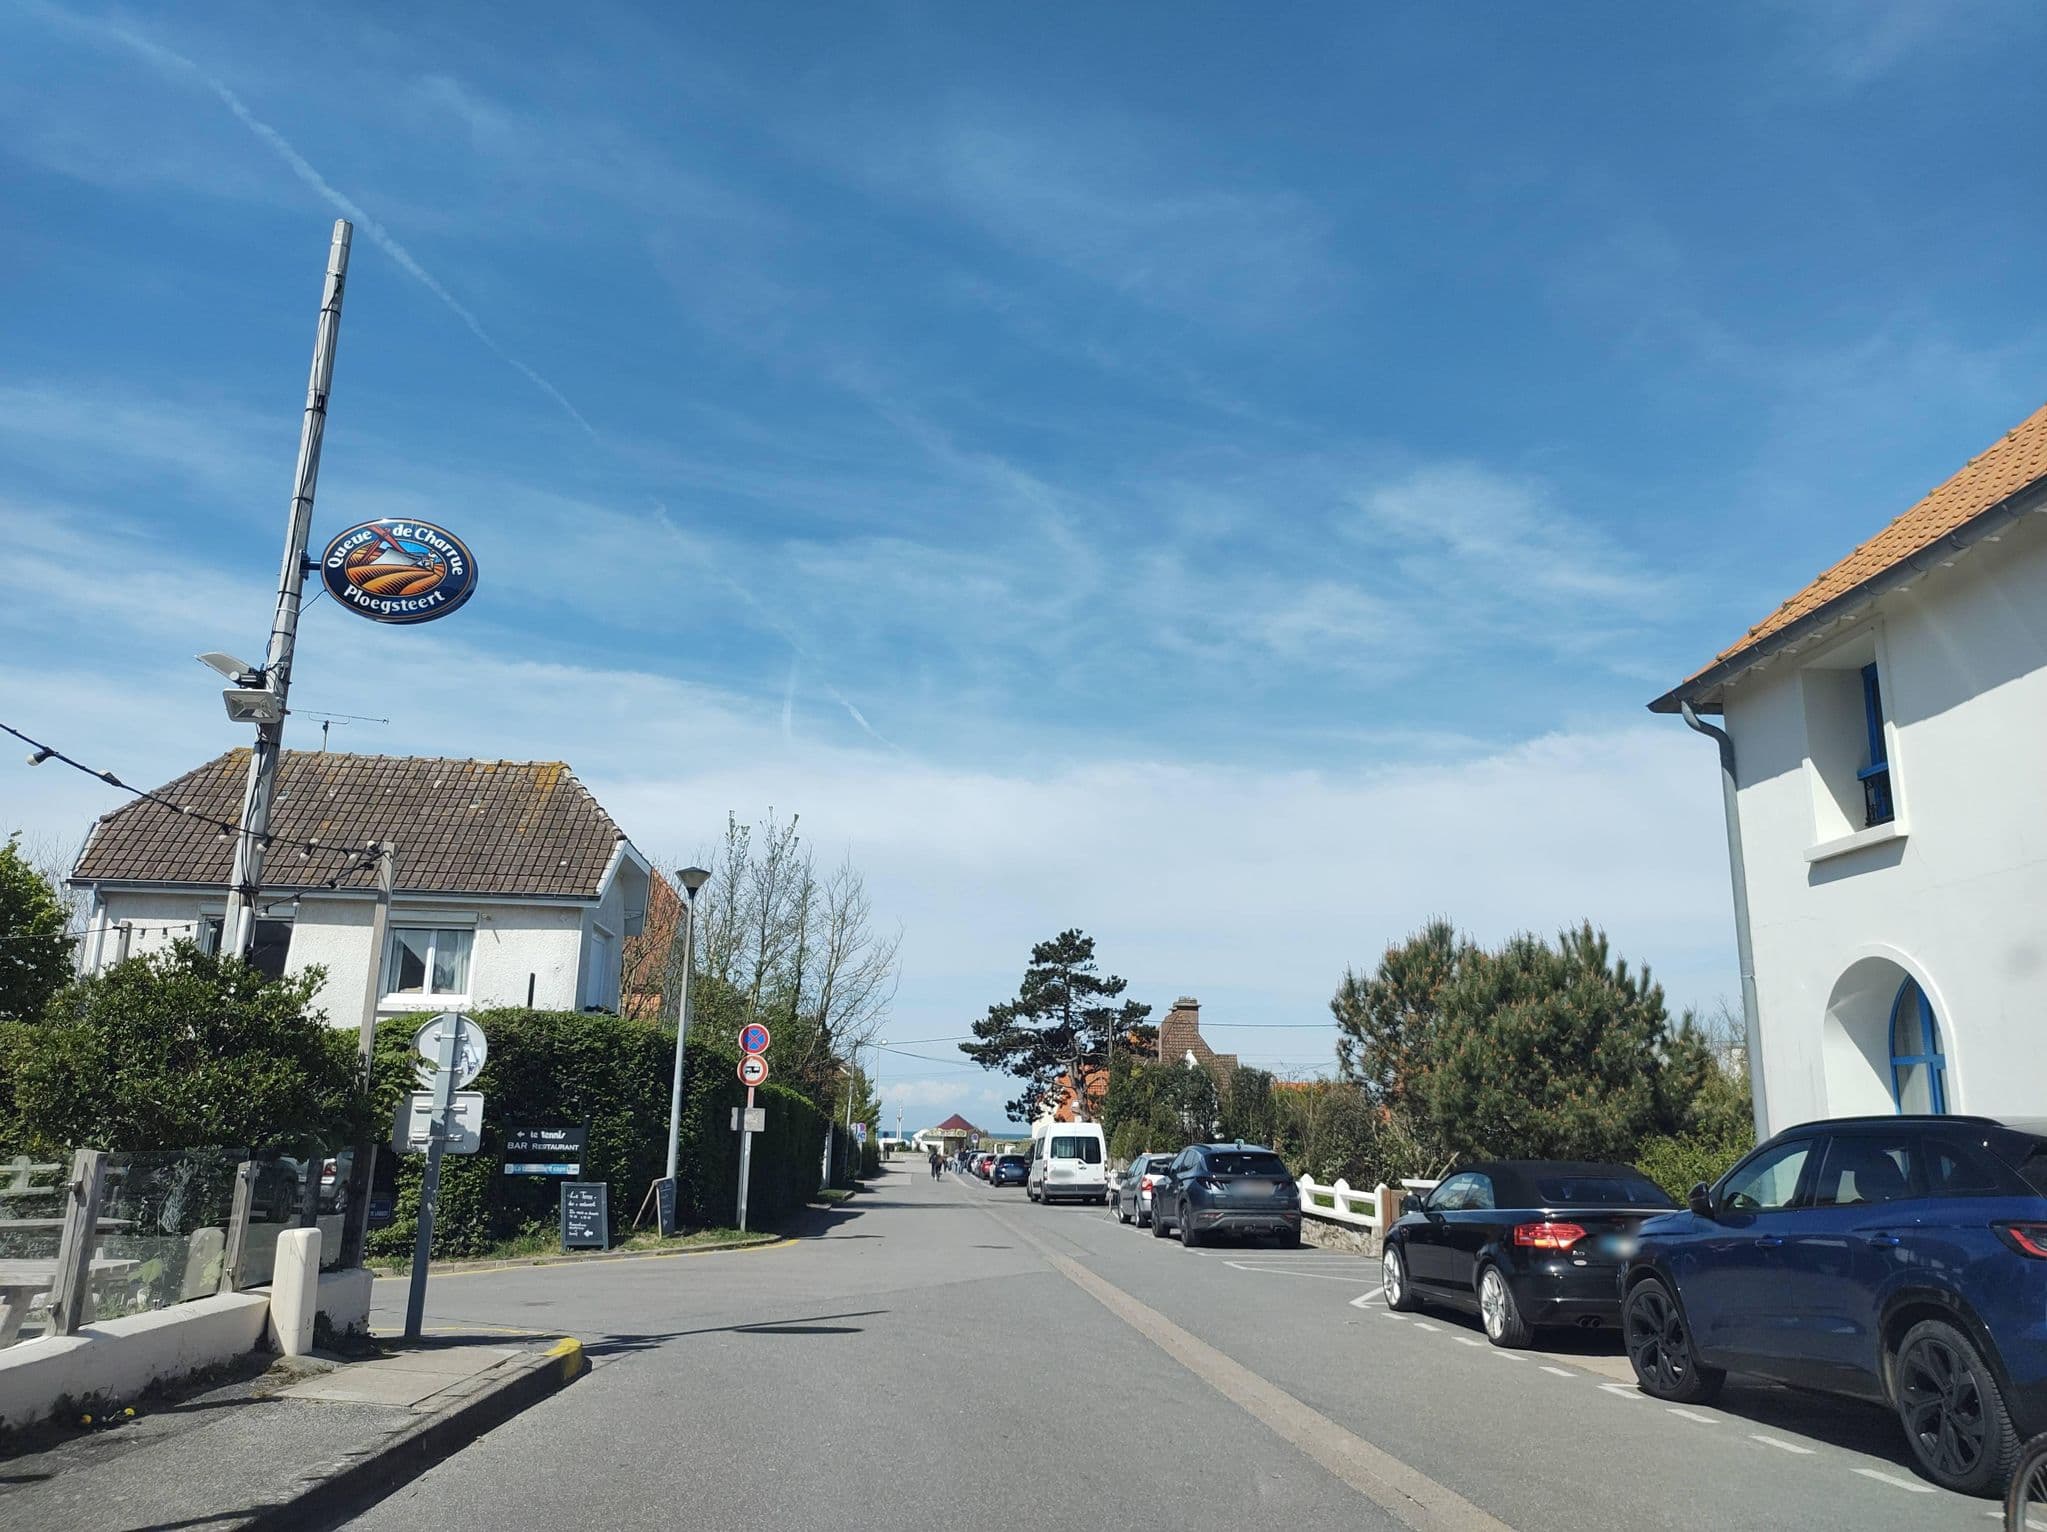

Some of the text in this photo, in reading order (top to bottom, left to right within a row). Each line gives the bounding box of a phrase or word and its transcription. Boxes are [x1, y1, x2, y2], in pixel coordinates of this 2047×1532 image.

[328, 524, 463, 576] Queue de Charrue
[343, 585, 446, 614] Ploegsteert
[507, 1142, 580, 1151] BAR RESTAURANT
